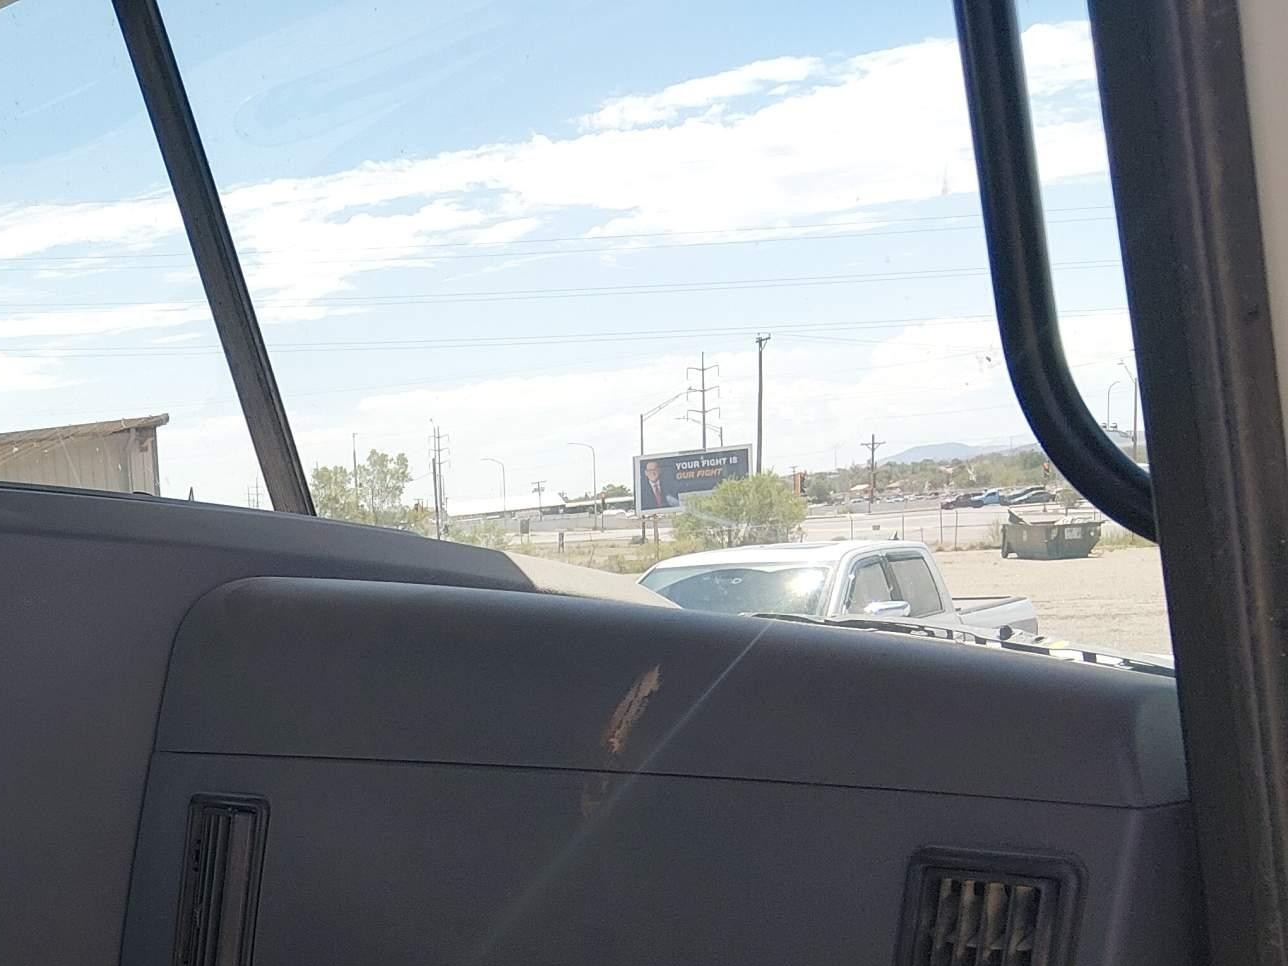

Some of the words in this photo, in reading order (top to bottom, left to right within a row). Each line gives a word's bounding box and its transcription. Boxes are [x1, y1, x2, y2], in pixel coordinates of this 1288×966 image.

[675, 460, 700, 470] YOUR
[701, 457, 727, 467] FIGHT
[729, 456, 738, 464] IS
[676, 471, 695, 480] OUR
[696, 468, 723, 478] FIGHT
